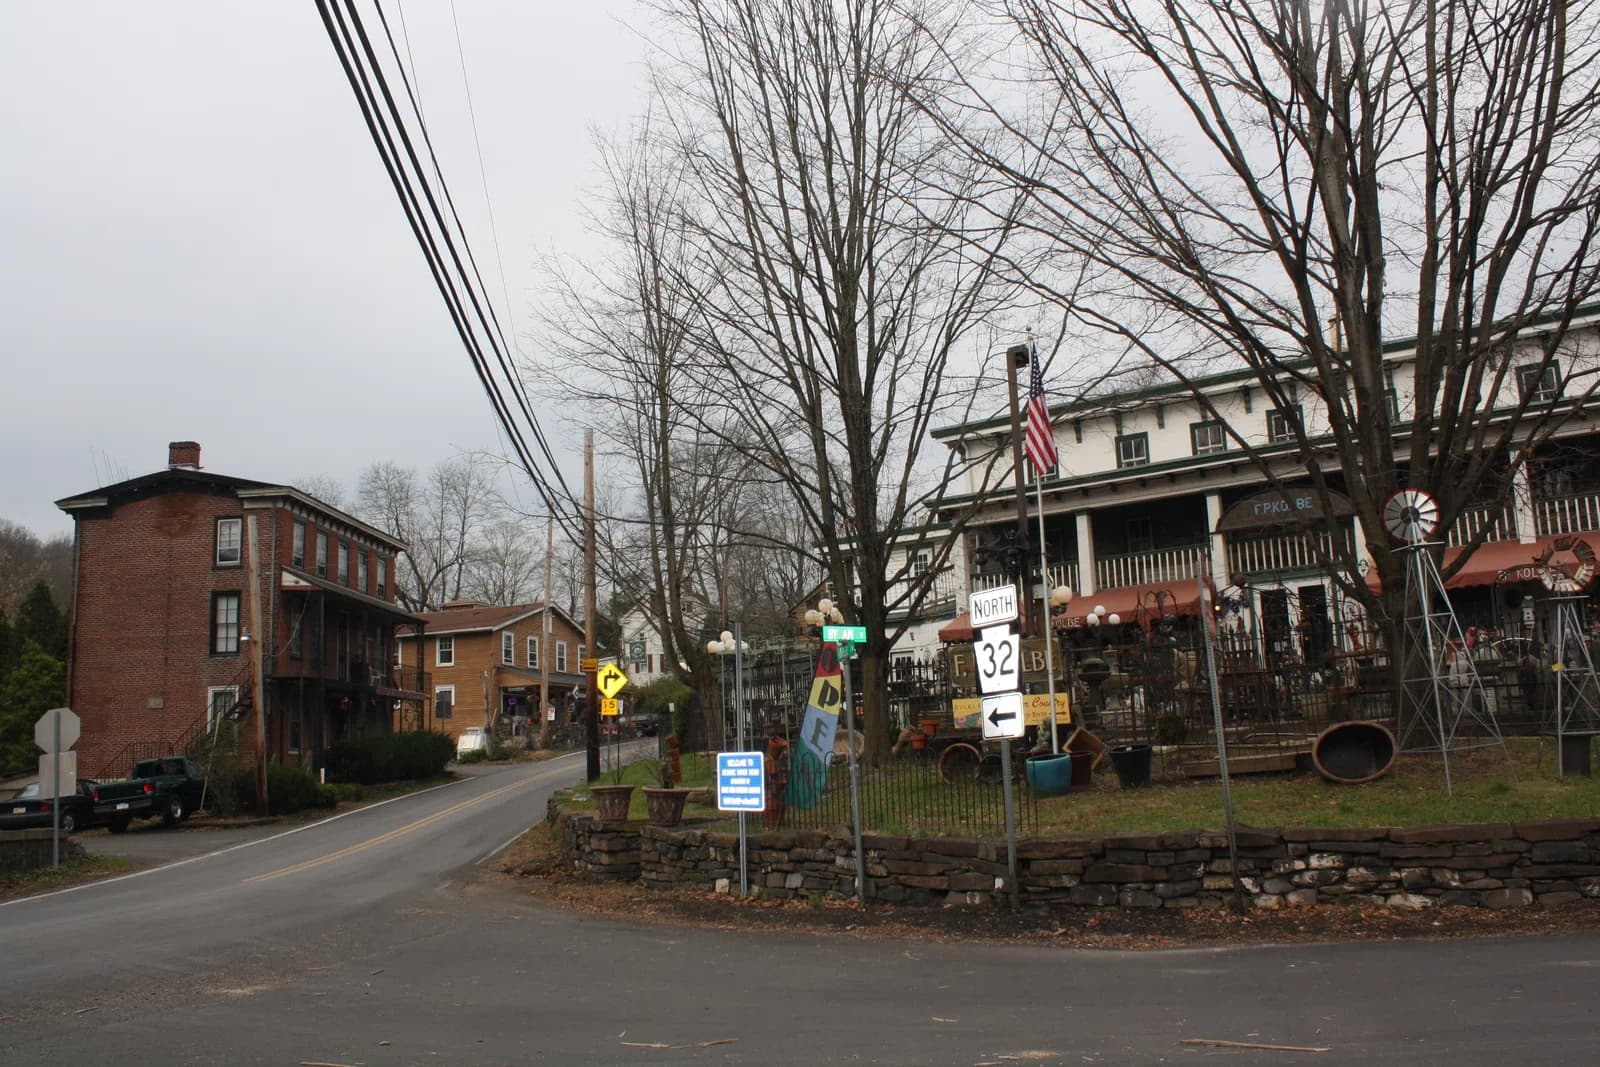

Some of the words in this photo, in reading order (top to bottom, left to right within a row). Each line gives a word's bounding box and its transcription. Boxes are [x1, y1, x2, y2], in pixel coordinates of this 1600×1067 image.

[973, 594, 1013, 620] NORTH
[983, 640, 1014, 678] 32
[603, 701, 616, 709] 15
